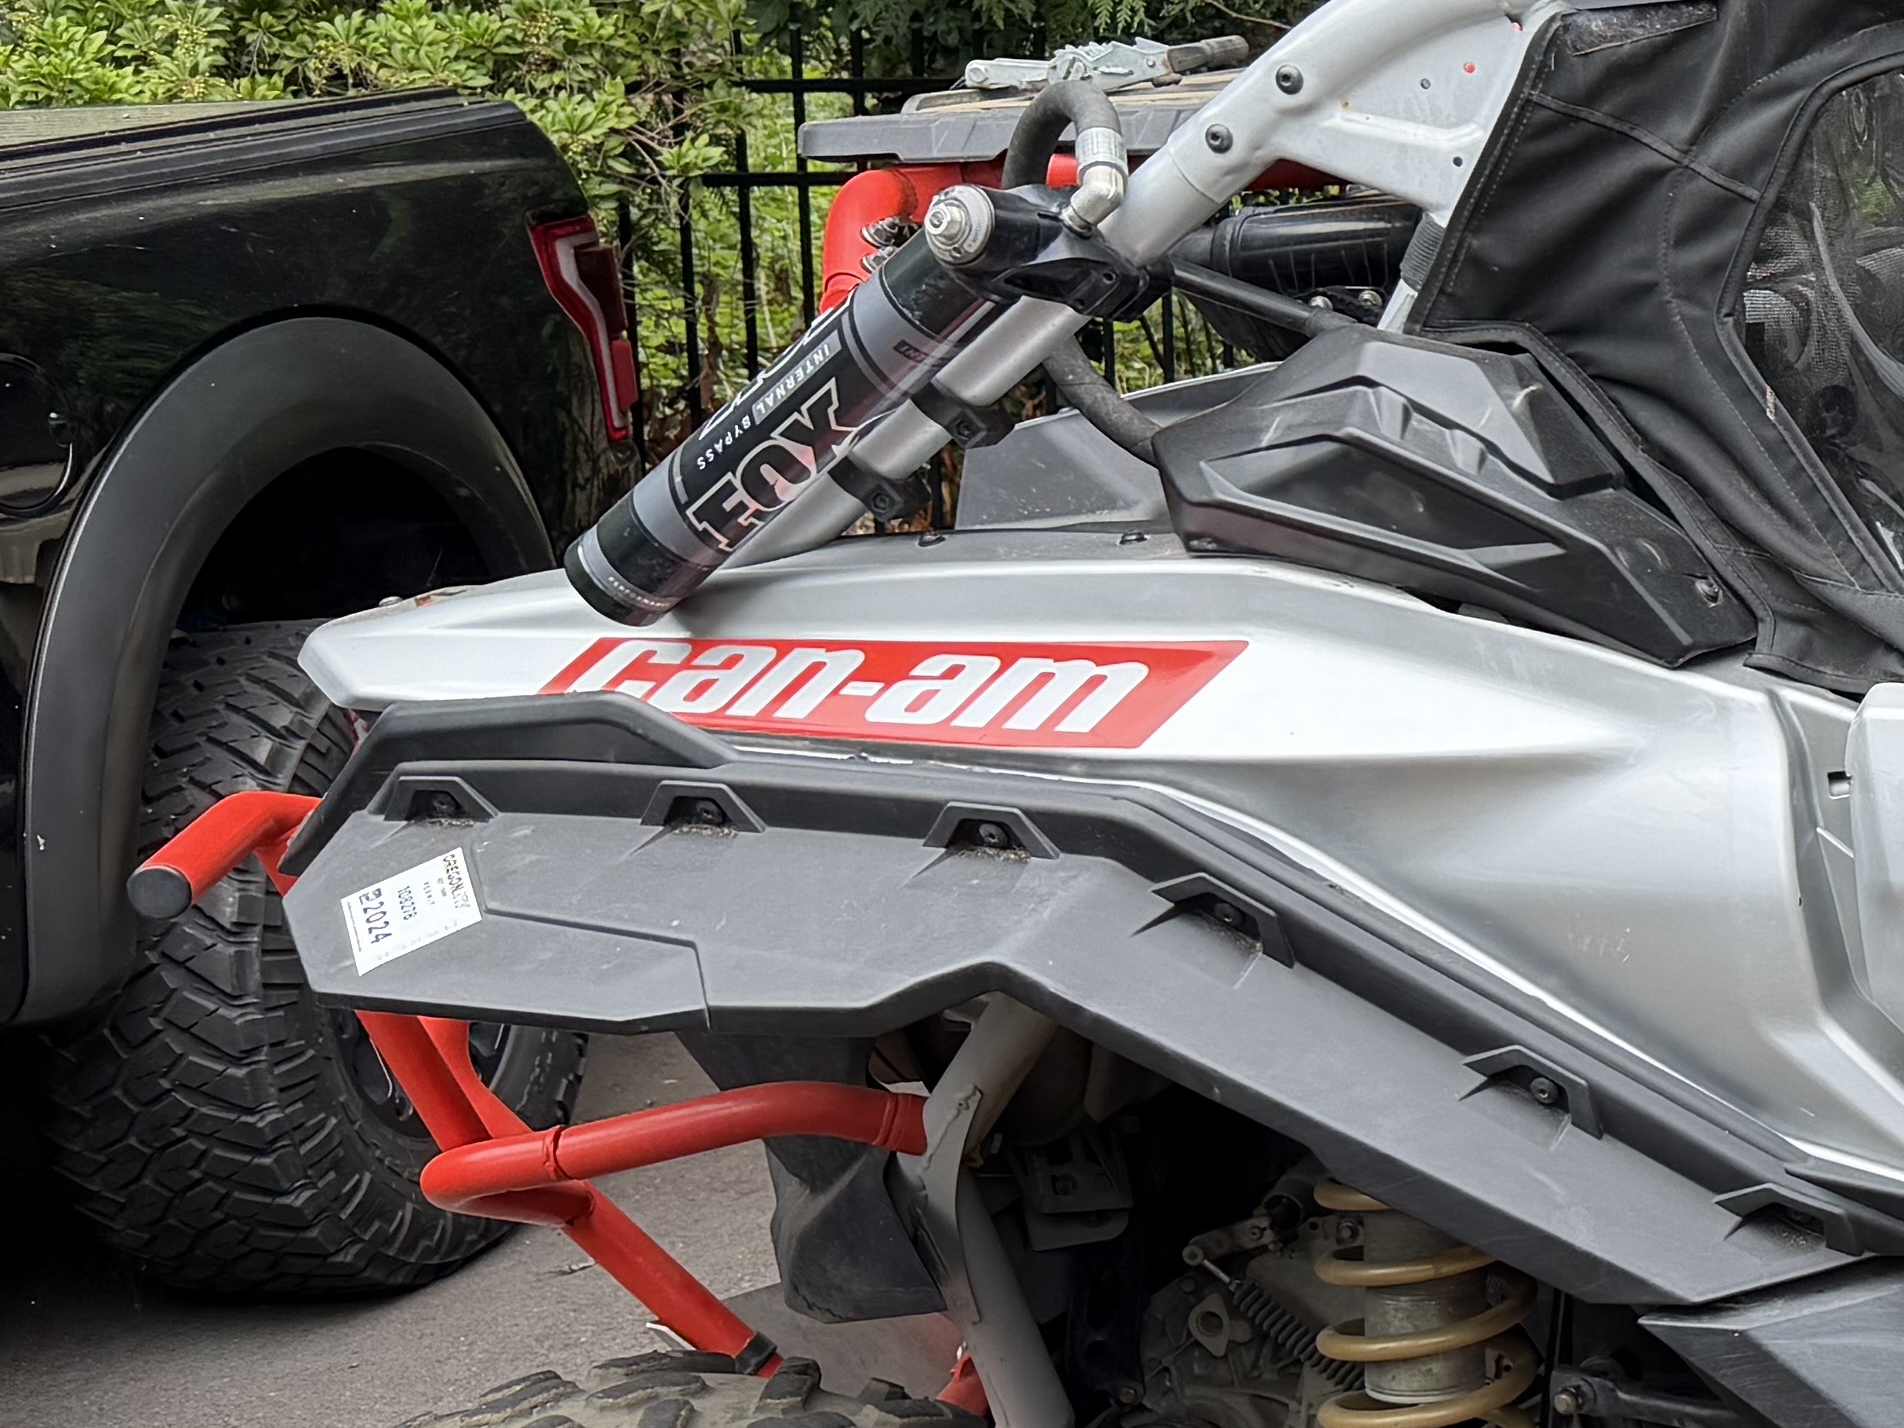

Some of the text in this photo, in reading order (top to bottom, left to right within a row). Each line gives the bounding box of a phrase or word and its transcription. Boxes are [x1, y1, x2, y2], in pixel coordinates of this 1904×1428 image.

[755, 342, 831, 415] INTERNAL
[686, 376, 858, 552] FOX
[696, 414, 752, 471] BYPASS
[569, 638, 1150, 734] can-am
[362, 900, 393, 944] 2024
